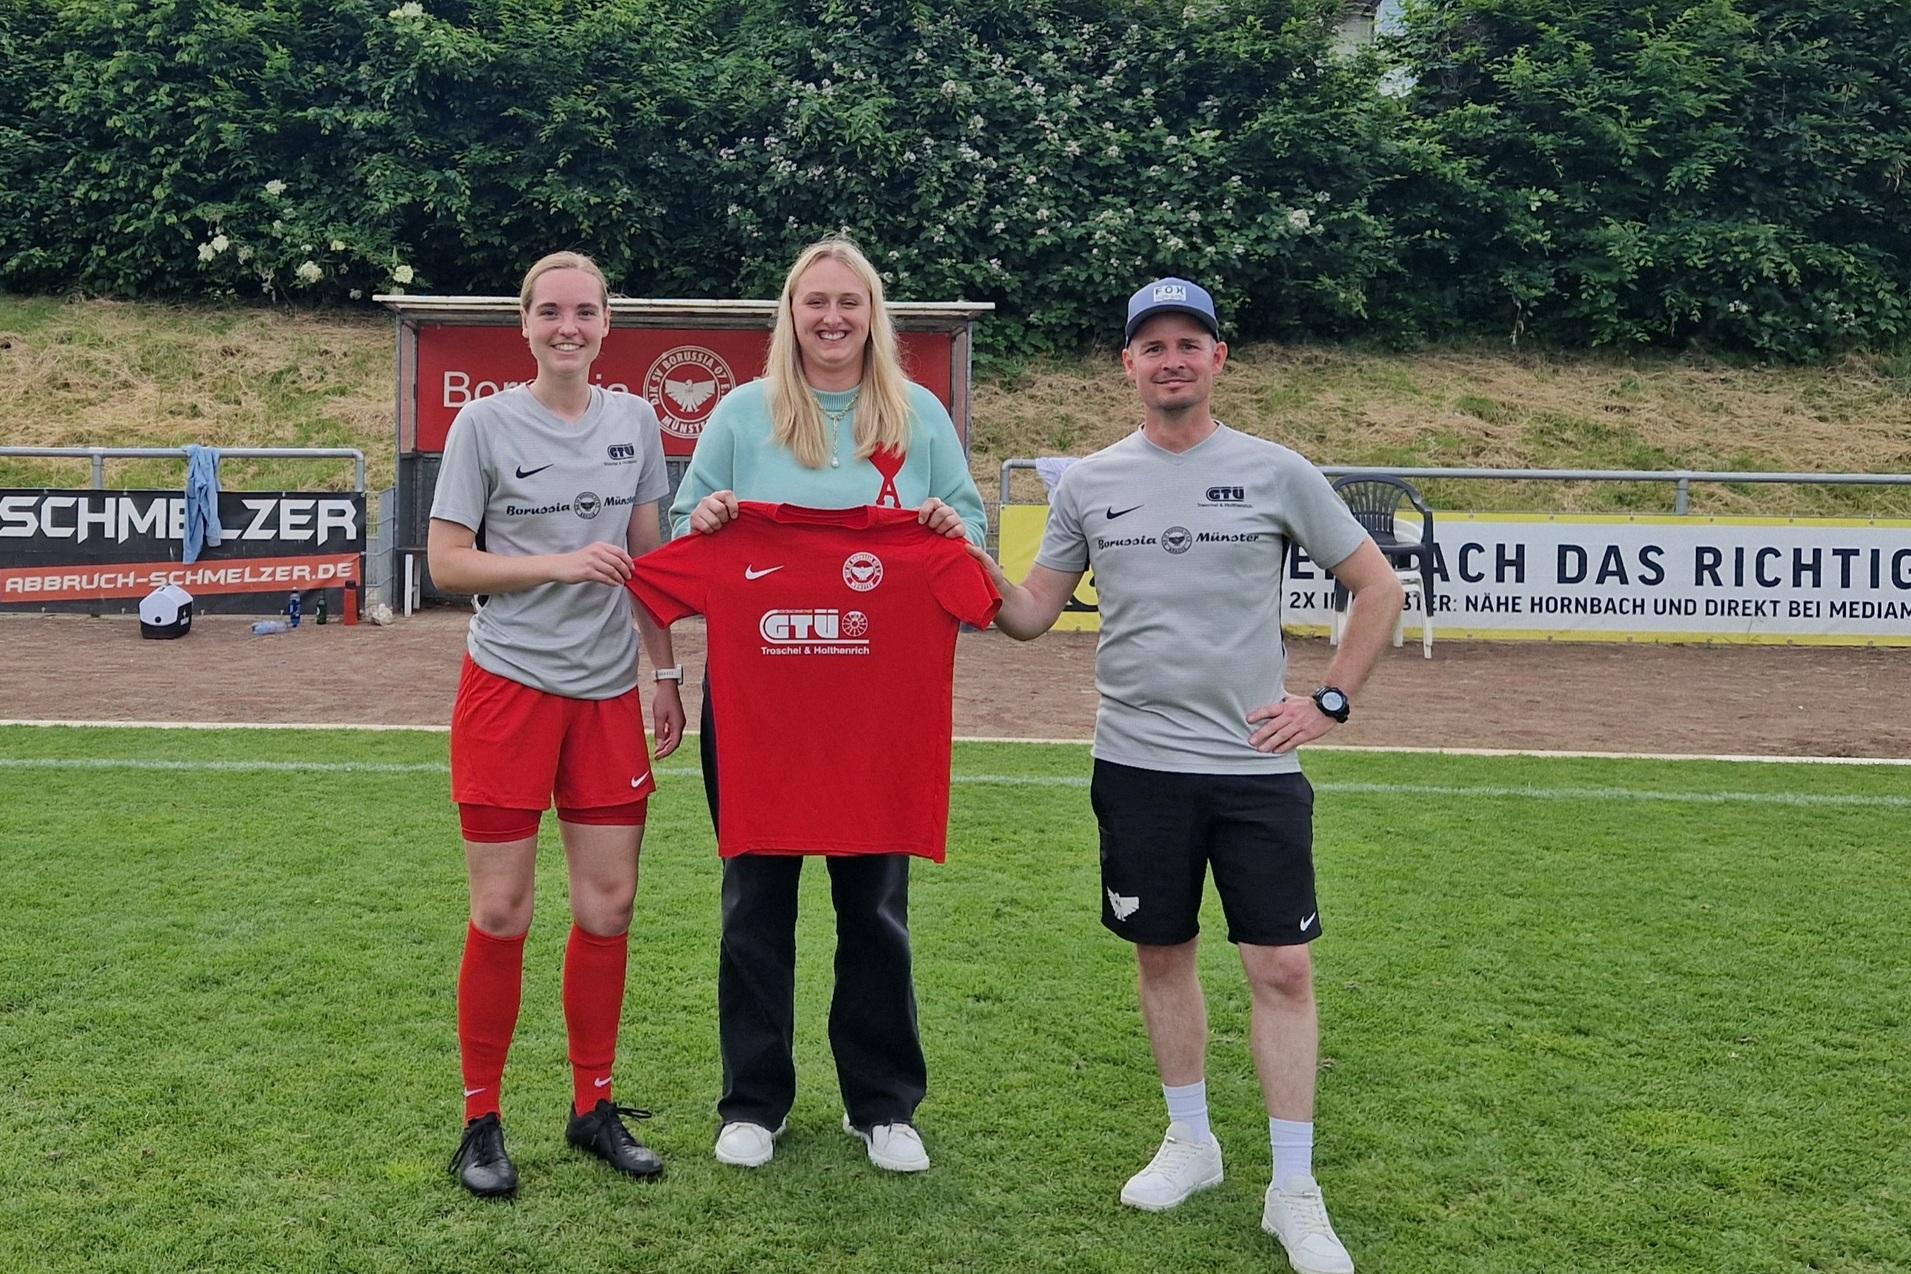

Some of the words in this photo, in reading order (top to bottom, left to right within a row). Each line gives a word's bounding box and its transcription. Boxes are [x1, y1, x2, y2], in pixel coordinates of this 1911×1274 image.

[1155, 286, 1184, 295] FOX
[651, 368, 664, 383] SV
[661, 351, 715, 370] BORUSSIA
[714, 366, 728, 379] 07
[506, 502, 570, 516] Borussia
[1098, 535, 1157, 551] Borussia
[1195, 532, 1259, 543] Münster
[5, 562, 354, 593] ABBRUCH-SCHMELZER.DE
[1557, 544, 1665, 586] DAS
[1695, 546, 1911, 590] RICHTIG
[1290, 591, 1315, 609] 2X
[1465, 592, 1522, 613] NÄHE
[1530, 596, 1645, 615] HORNBACH
[1653, 598, 1697, 616] UND
[1705, 599, 1781, 618] DIREKT
[1788, 600, 1821, 618] BEI
[762, 608, 839, 640] GTÜ
[761, 646, 801, 655] Troschel
[804, 646, 811, 655] &
[814, 646, 870, 655] Holthenrich
